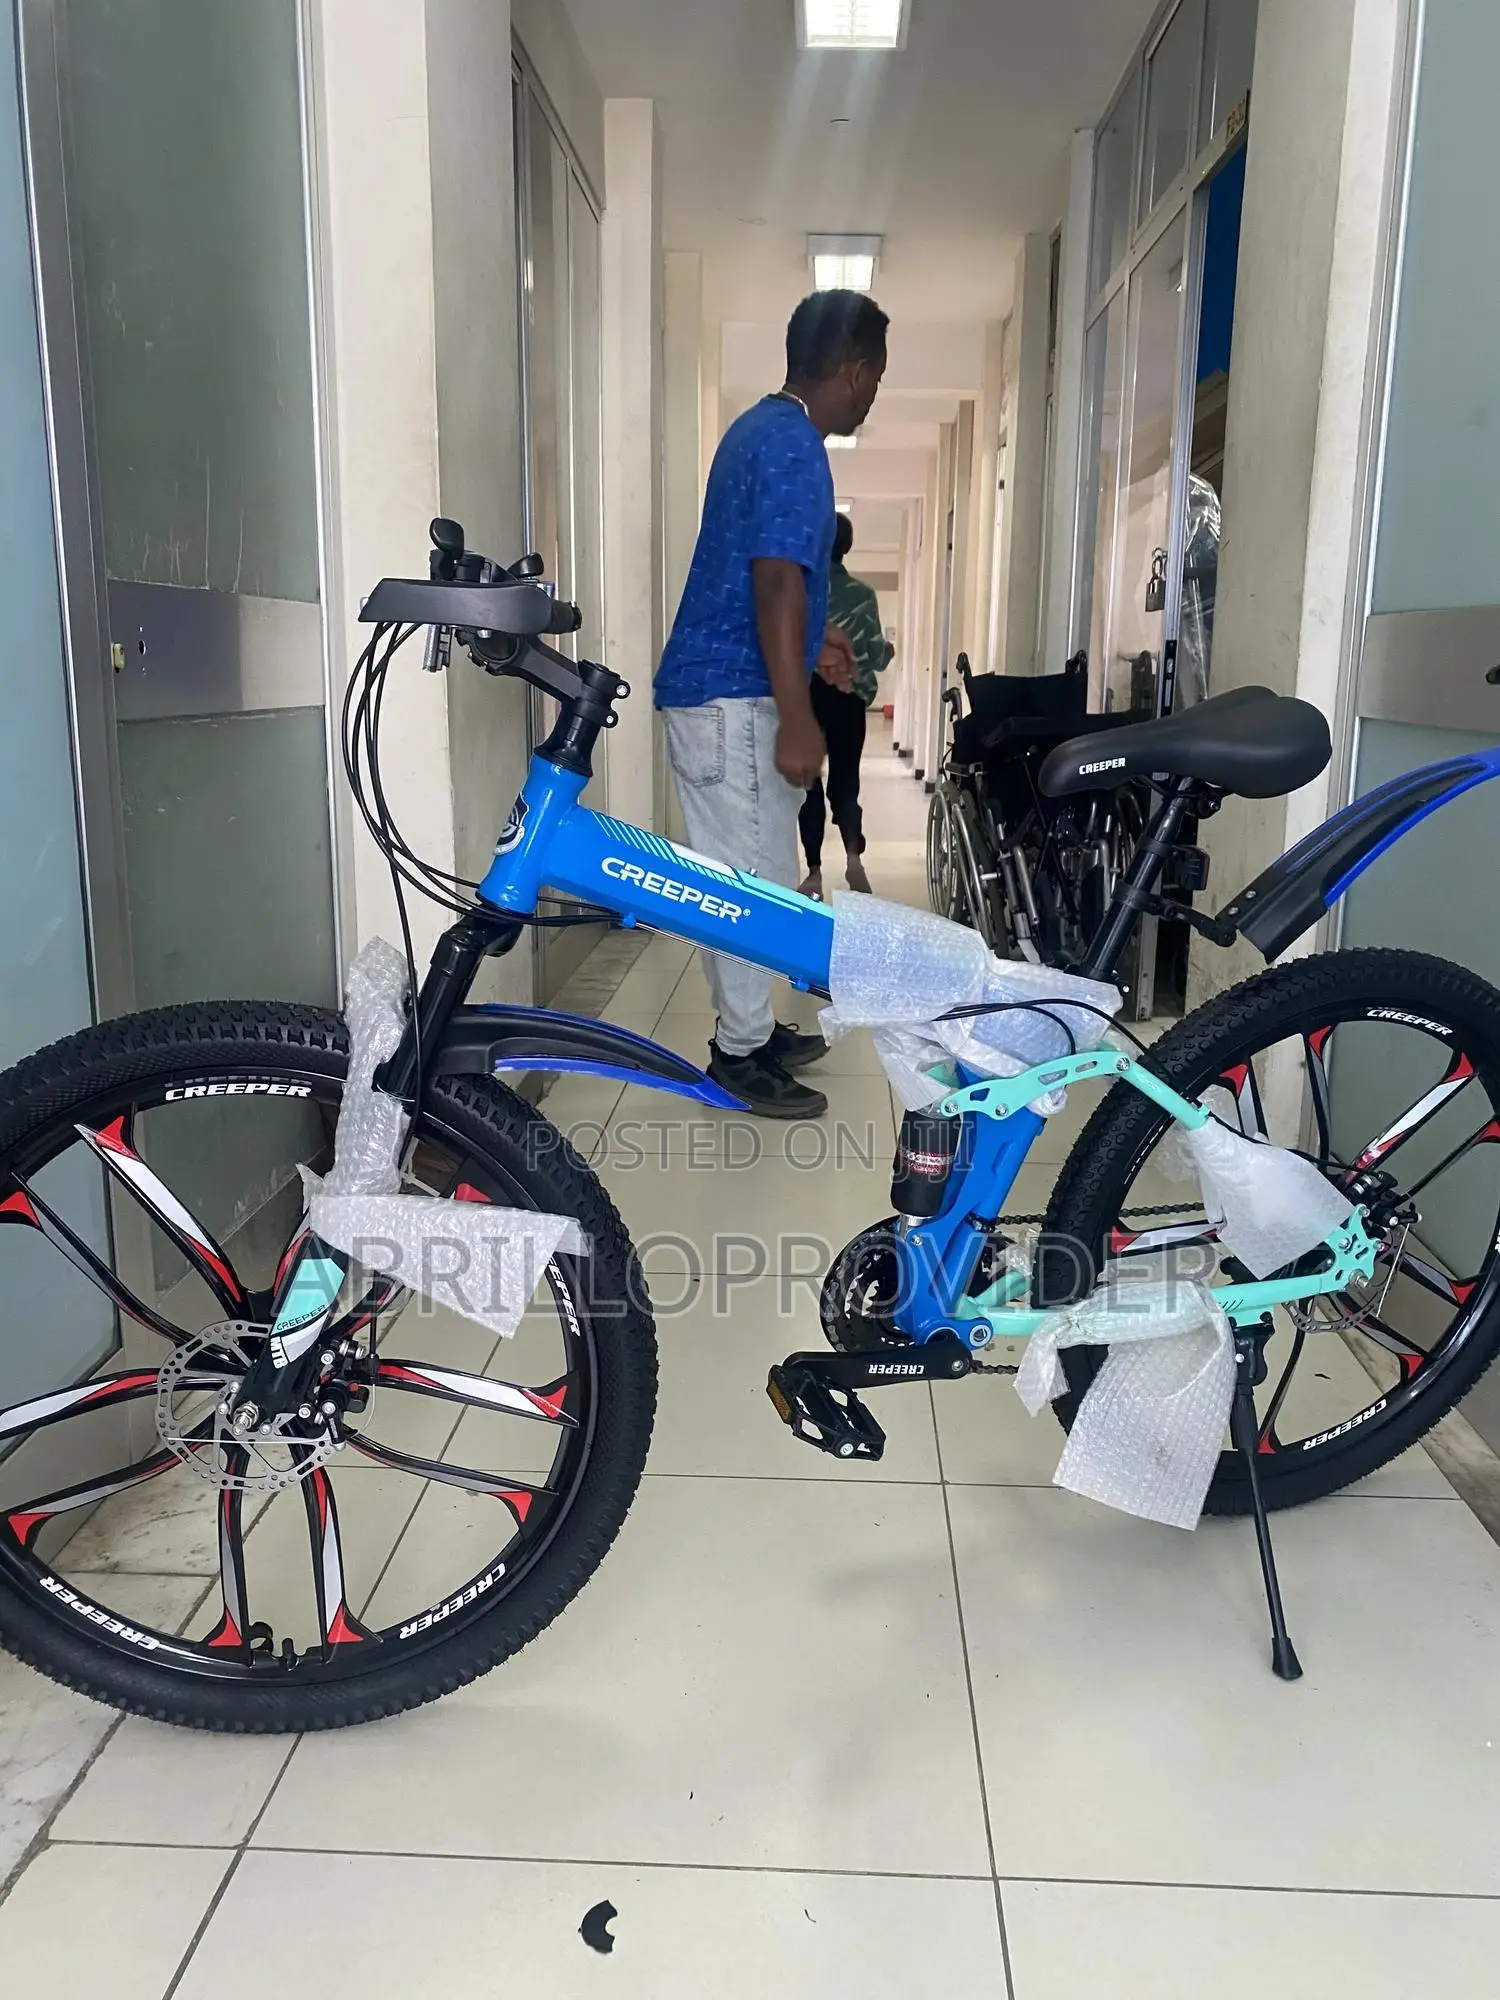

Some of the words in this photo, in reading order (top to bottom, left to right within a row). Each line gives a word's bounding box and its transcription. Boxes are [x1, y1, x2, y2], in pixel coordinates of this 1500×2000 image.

[1078, 757, 1126, 775] CREEPER
[1366, 1009, 1454, 1036] CREEPER
[165, 1083, 312, 1101] CREEPER
[547, 1255, 581, 1337] EPER
[276, 1304, 326, 1331] CREEPER
[270, 1336, 289, 1370] MTB
[868, 1364, 925, 1375] CREEPER
[1302, 1398, 1387, 1451] CREEPER
[39, 1576, 160, 1651] CREEPER
[399, 1562, 506, 1640] CREEPER
